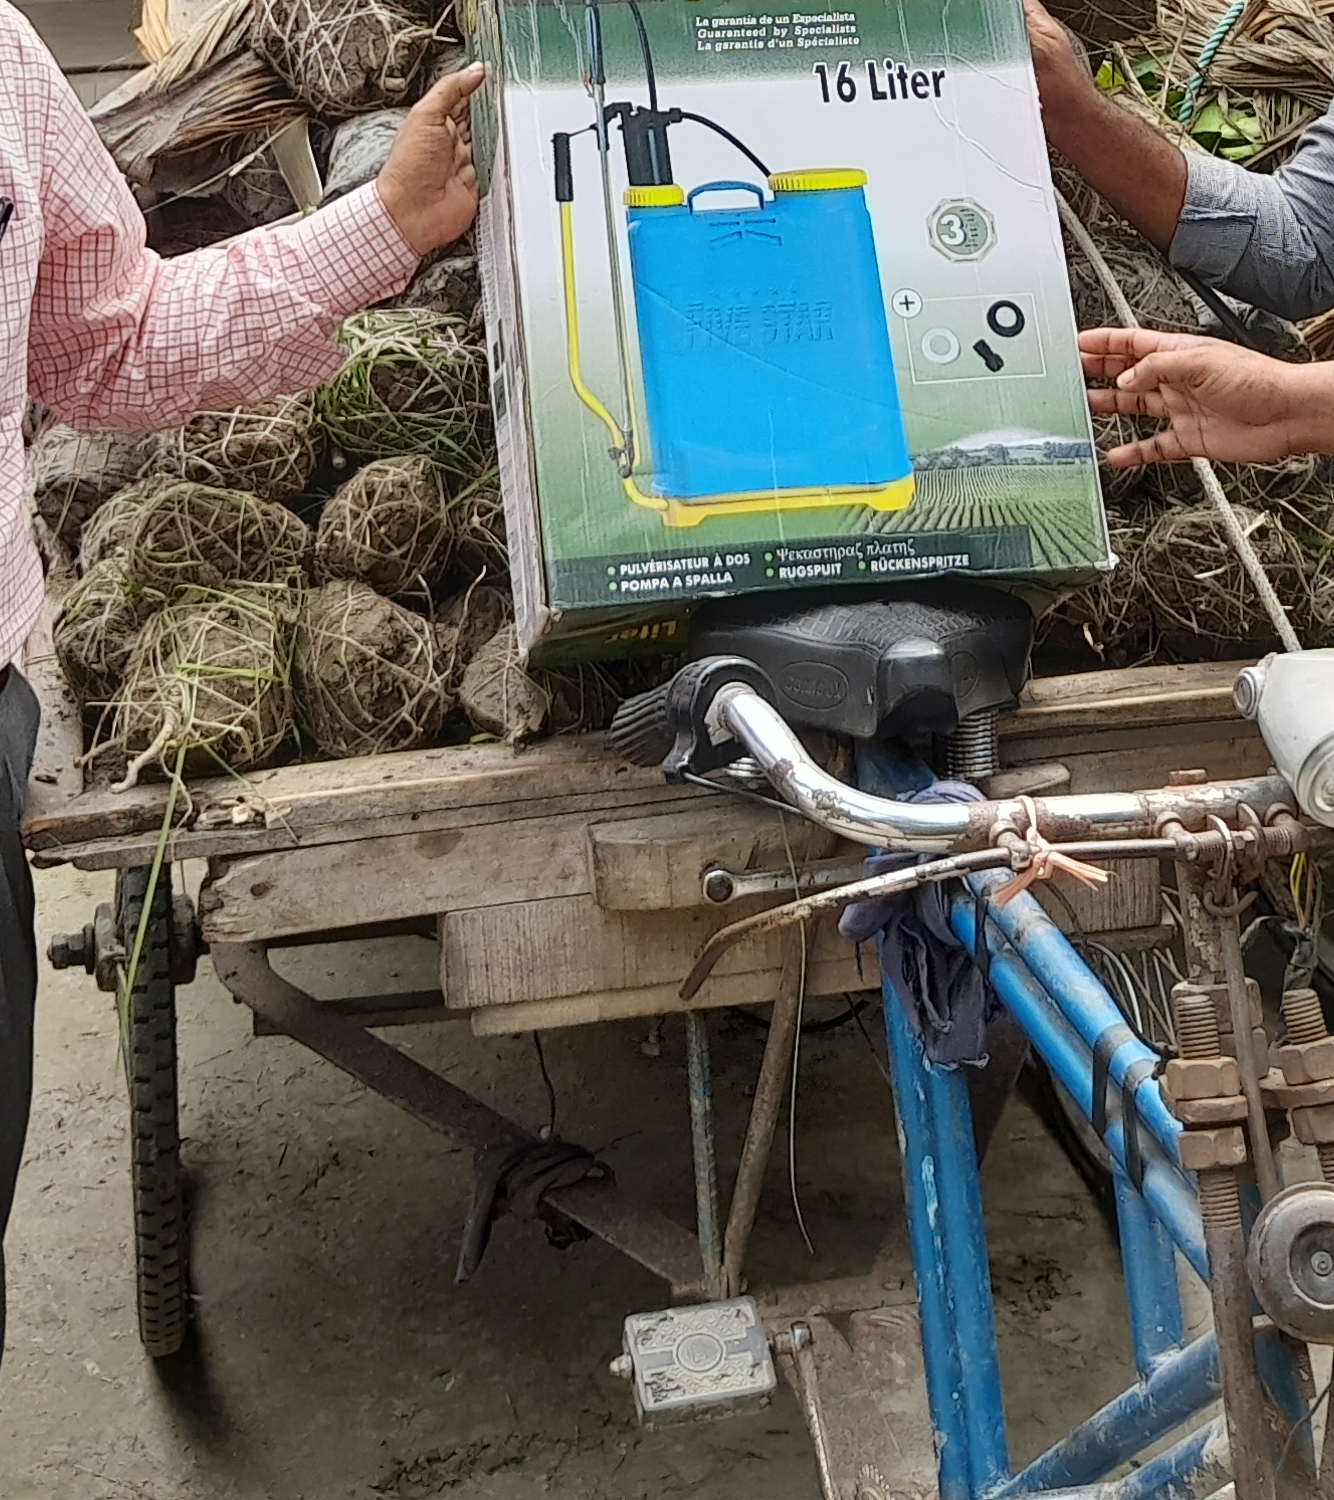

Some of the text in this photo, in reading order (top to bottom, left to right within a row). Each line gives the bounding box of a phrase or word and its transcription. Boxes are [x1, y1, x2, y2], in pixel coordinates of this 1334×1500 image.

[695, 16, 709, 27] La
[775, 14, 790, 24] un
[697, 23, 857, 38] Guaranteed by Specialists
[697, 39, 712, 51] La
[768, 36, 794, 48] d'un
[814, 58, 946, 103] 16 Liter
[939, 212, 967, 248] 3
[725, 552, 751, 567] DOS
[778, 551, 970, 579] RUGSPUIT RÜCKENSPRITZE
[620, 571, 733, 592] POMPA A SPALLA
